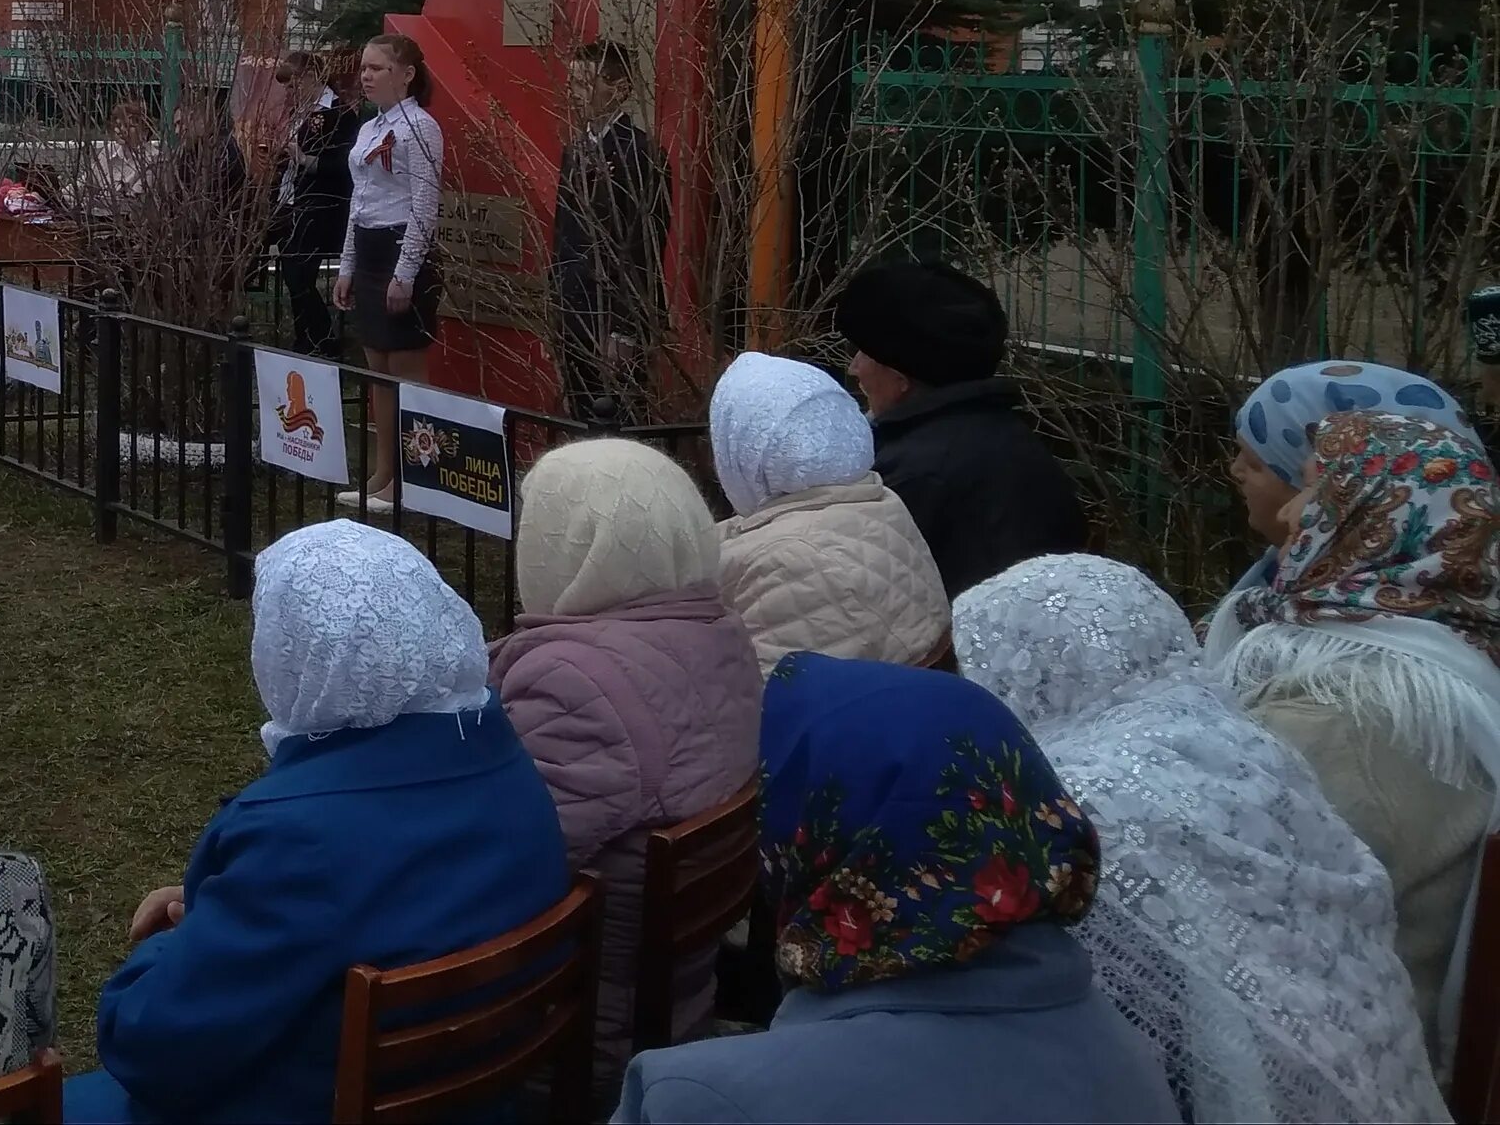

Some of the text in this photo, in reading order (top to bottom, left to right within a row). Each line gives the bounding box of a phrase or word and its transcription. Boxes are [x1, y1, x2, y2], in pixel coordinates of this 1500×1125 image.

[282, 442, 314, 462] ПОБЕДЫ
[465, 455, 501, 480] ЛИЦА
[440, 467, 502, 503] ПОБЕДЫ
